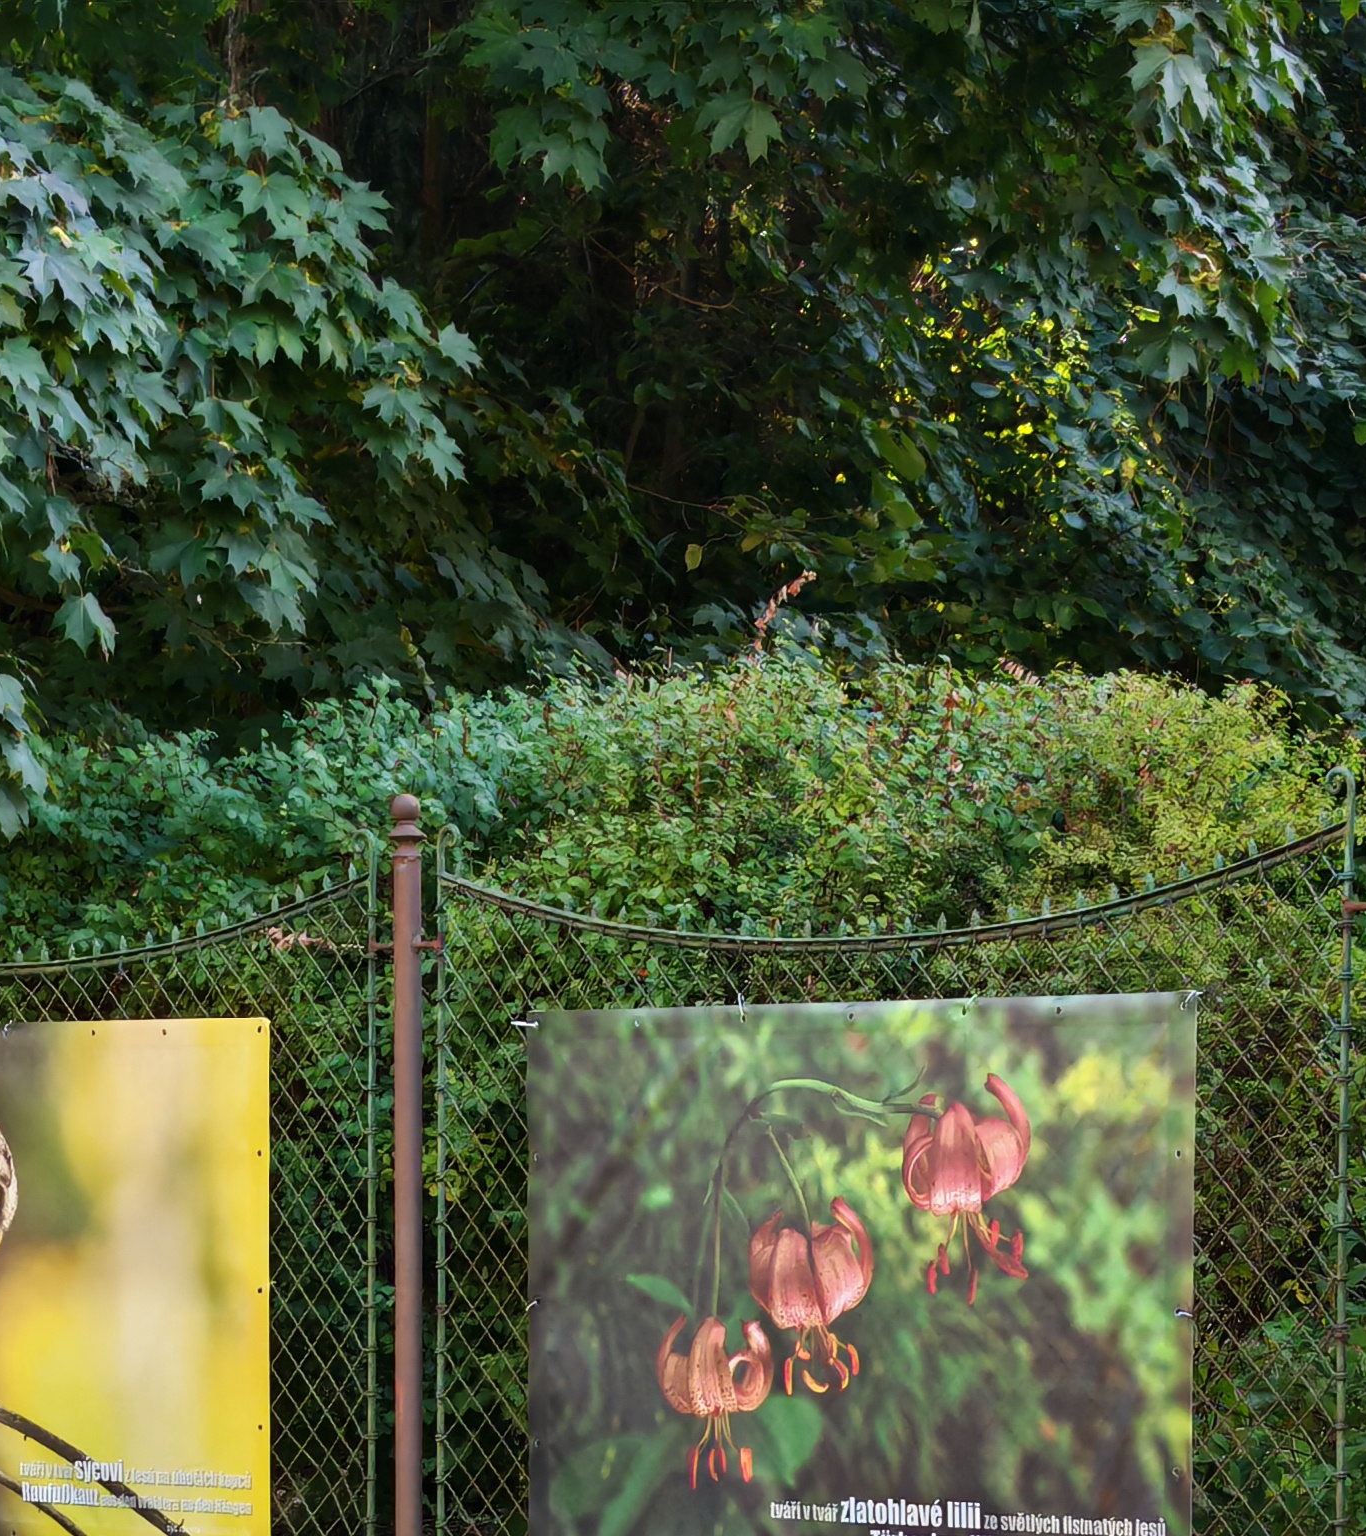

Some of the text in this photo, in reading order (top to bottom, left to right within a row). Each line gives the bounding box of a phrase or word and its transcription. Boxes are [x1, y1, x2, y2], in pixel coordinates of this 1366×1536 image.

[74, 1456, 124, 1483] sýcovi
[770, 1501, 801, 1520] tváří
[803, 1505, 811, 1520] v
[812, 1503, 838, 1522] tvář
[840, 1496, 943, 1528] zlatohlavé
[947, 1501, 981, 1529] lilii
[983, 1513, 998, 1530] ze
[1000, 1512, 1060, 1535] světlých
